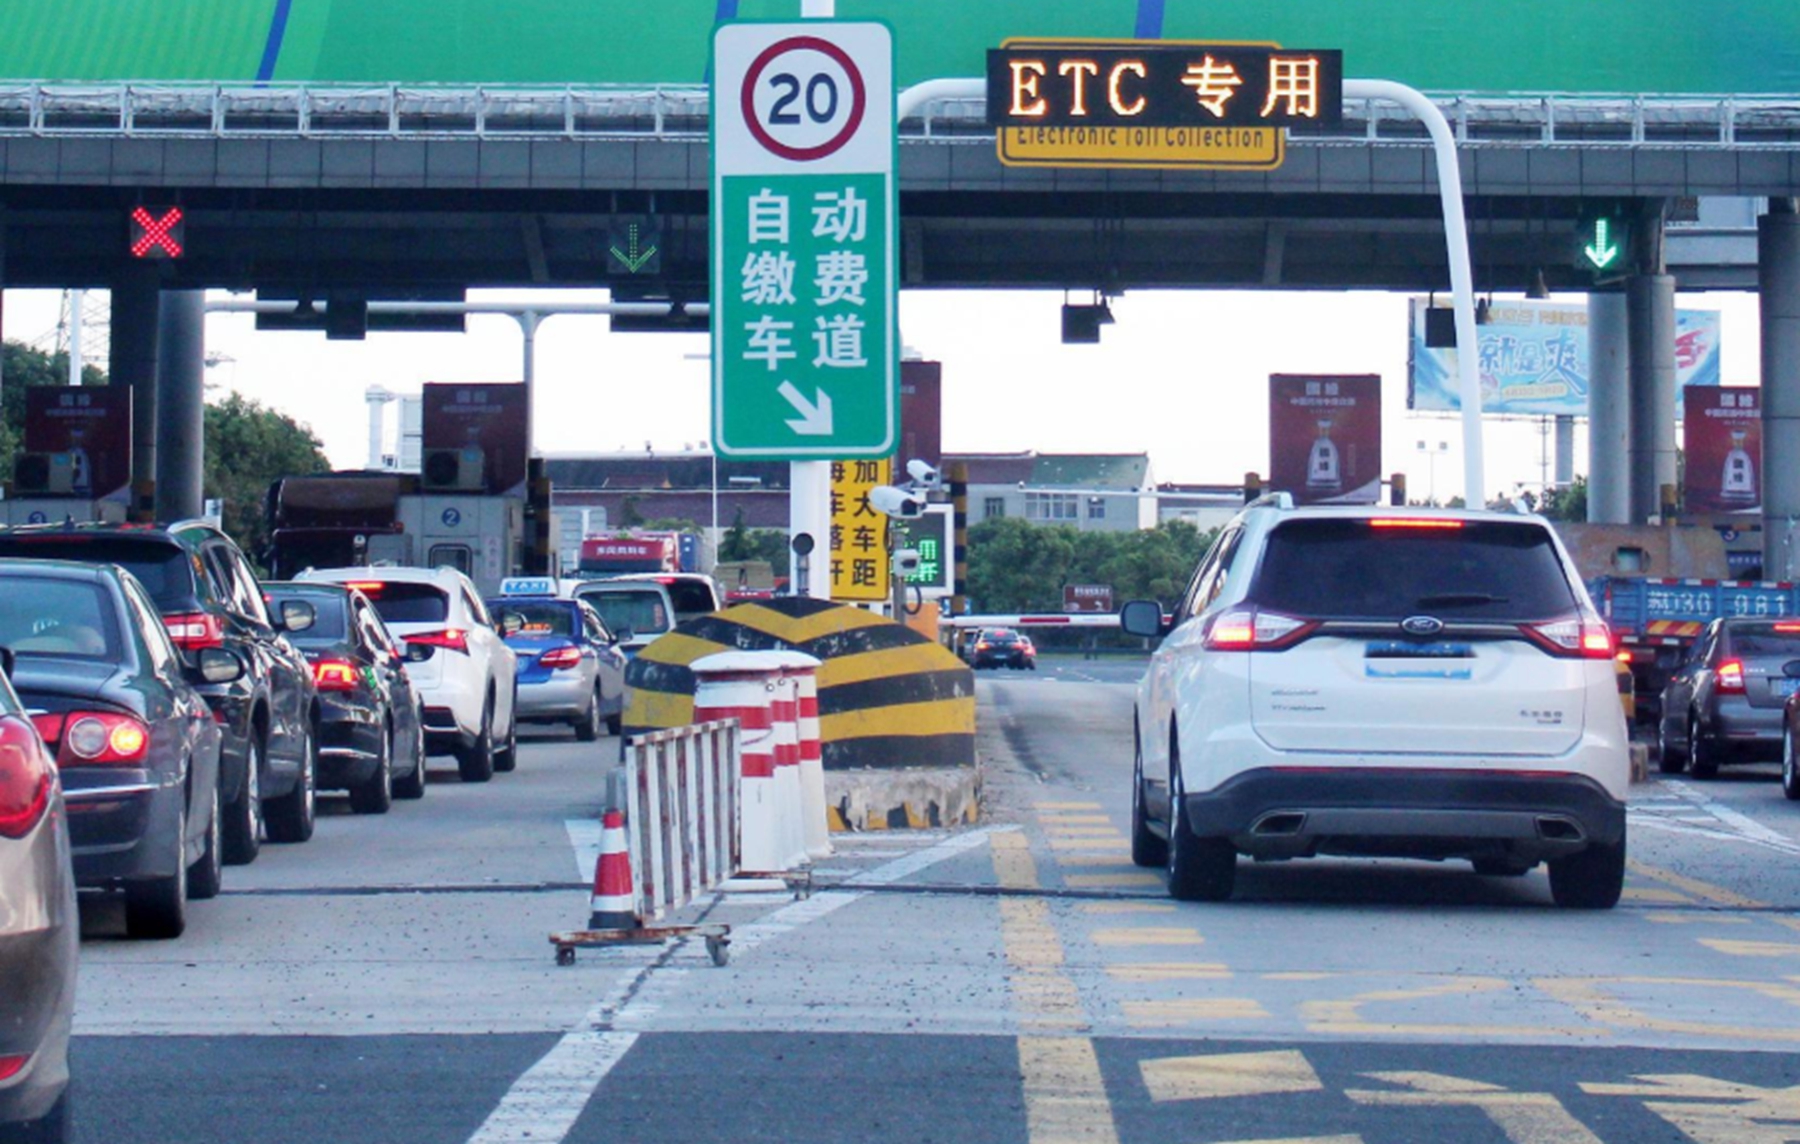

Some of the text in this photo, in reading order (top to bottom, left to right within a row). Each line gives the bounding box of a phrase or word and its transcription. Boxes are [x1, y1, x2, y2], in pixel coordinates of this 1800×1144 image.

[768, 72, 838, 125] 20
[1008, 51, 1319, 118] ETC 专用
[1165, 127, 1263, 148] Collection
[748, 187, 867, 244] 自动
[741, 250, 868, 306] 缴费
[742, 313, 868, 371] 车道
[445, 509, 457, 525] 2
[851, 459, 878, 587] 加大车距
[507, 580, 547, 592] TAXI
